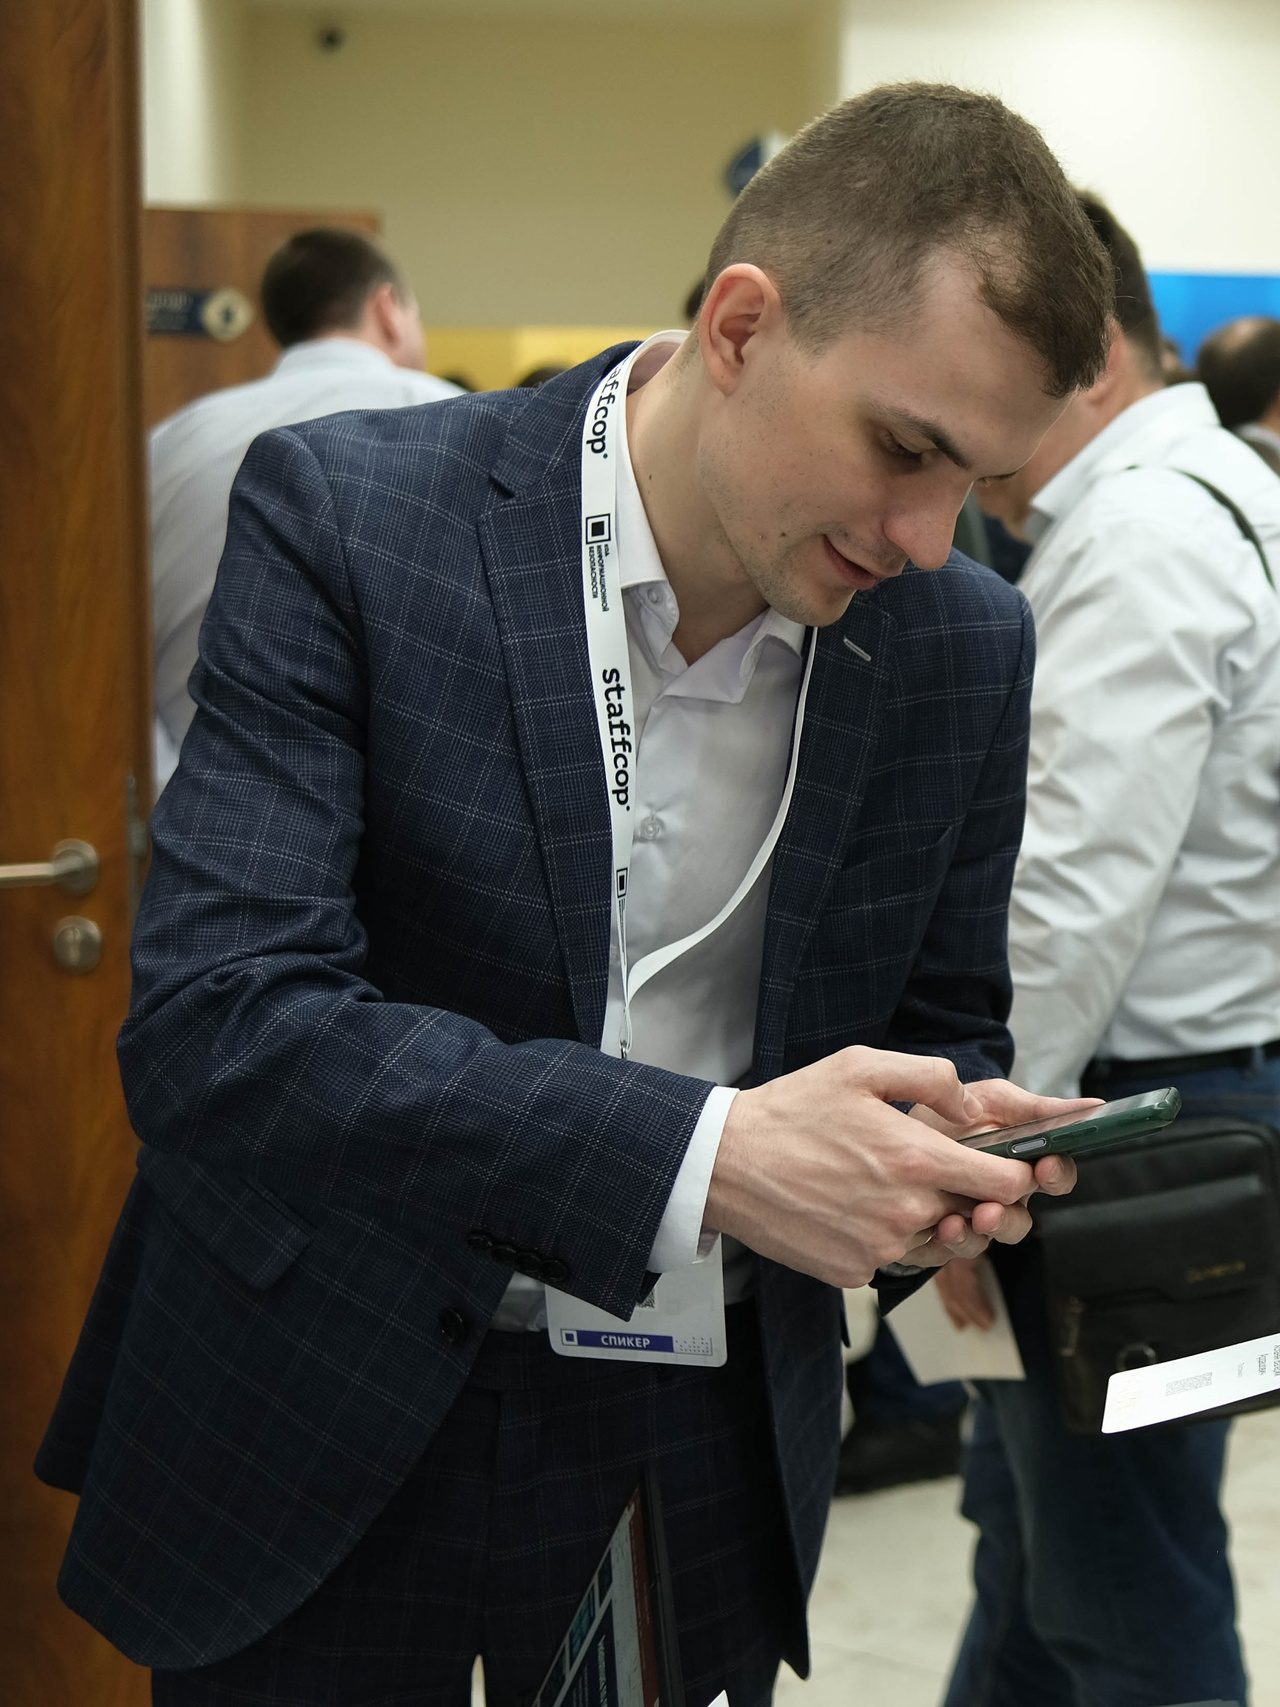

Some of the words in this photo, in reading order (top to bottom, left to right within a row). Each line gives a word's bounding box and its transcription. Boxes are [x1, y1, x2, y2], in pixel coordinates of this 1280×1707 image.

[586, 357, 628, 454] affcop
[589, 546, 598, 599] БЕЗОПАСНОСТИ
[602, 668, 632, 806] staffcop
[601, 1334, 651, 1348] СПИКЕР
